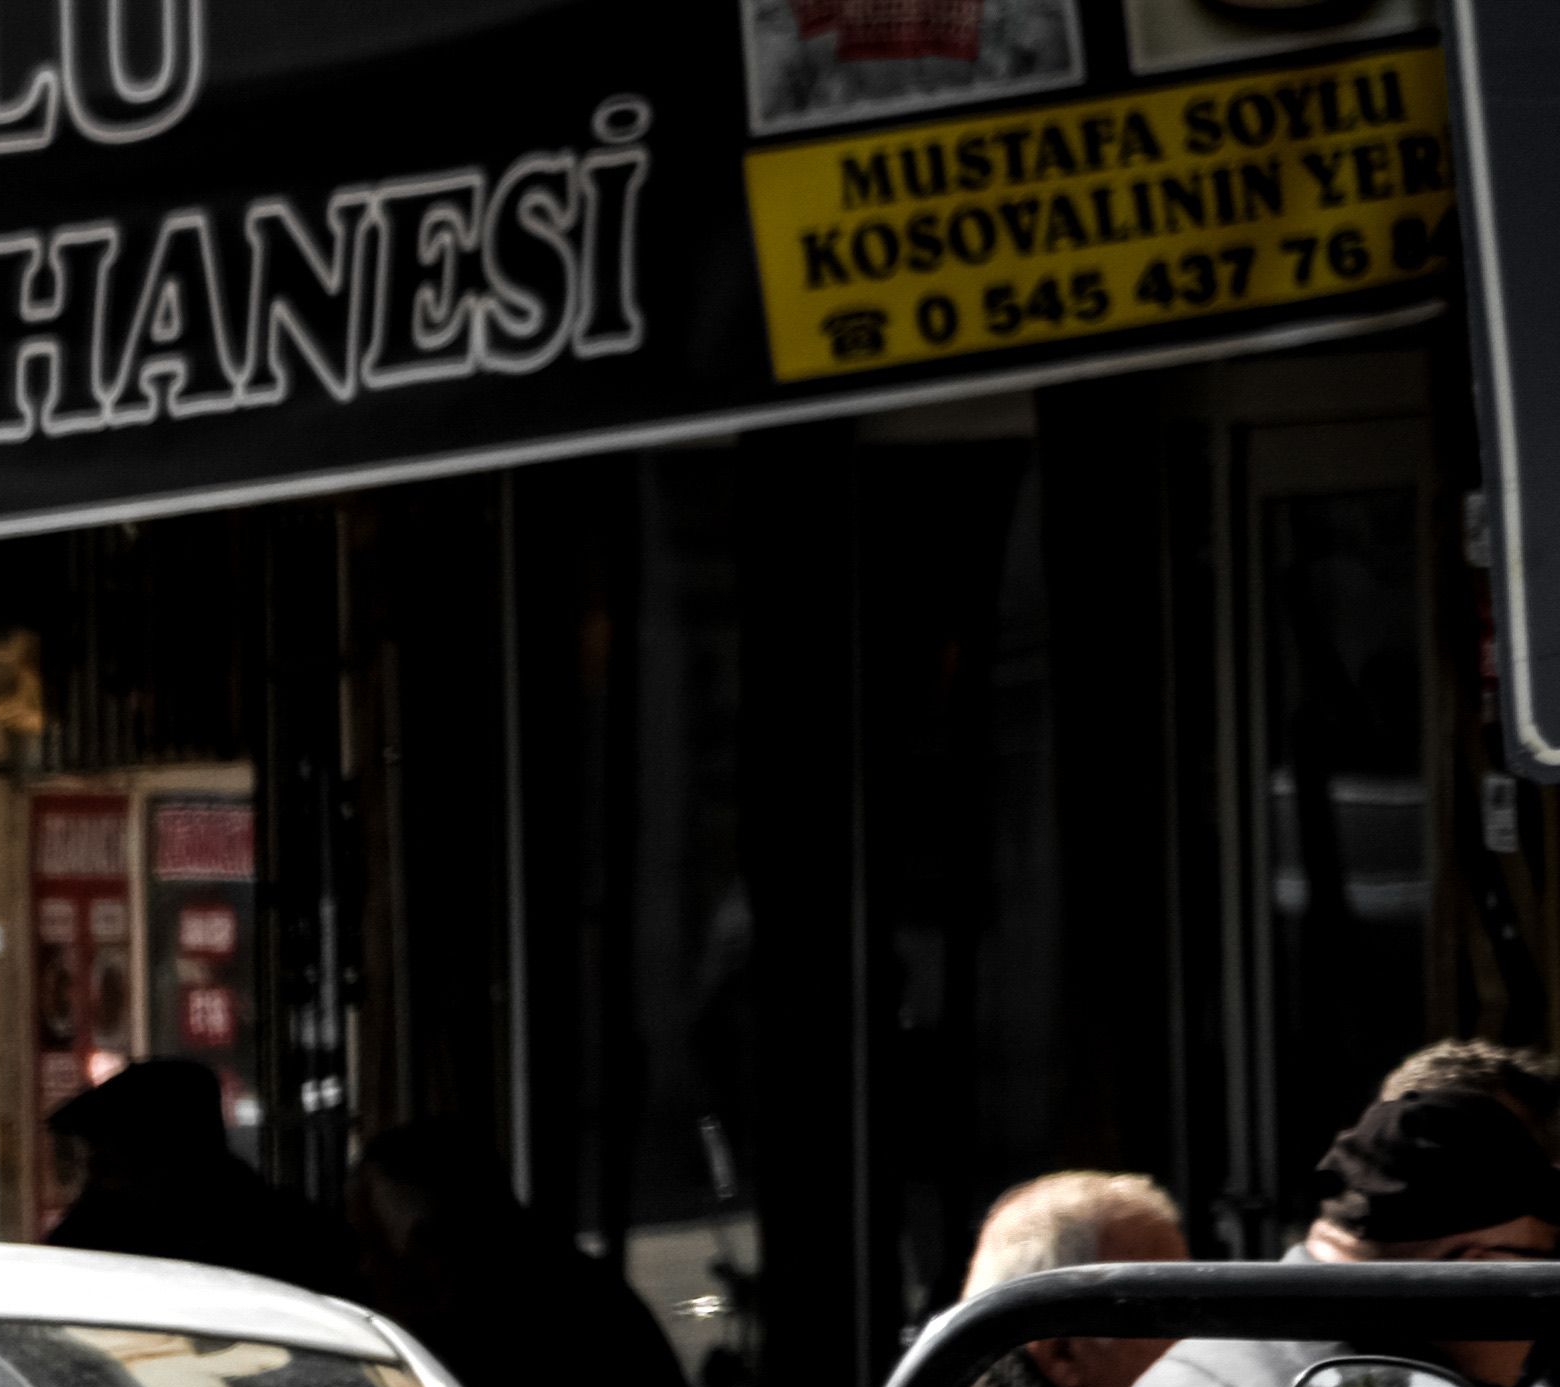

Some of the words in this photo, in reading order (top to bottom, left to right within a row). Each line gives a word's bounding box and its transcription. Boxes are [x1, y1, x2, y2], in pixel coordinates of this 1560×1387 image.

[839, 108, 1161, 211] MUSTAFA
[1183, 69, 1407, 154] SOYLU
[798, 158, 1289, 290] KOSOVALININ
[918, 294, 958, 346] 0
[982, 268, 1111, 333] 545
[1136, 245, 1257, 310] 437
[1281, 226, 1370, 290] 76
